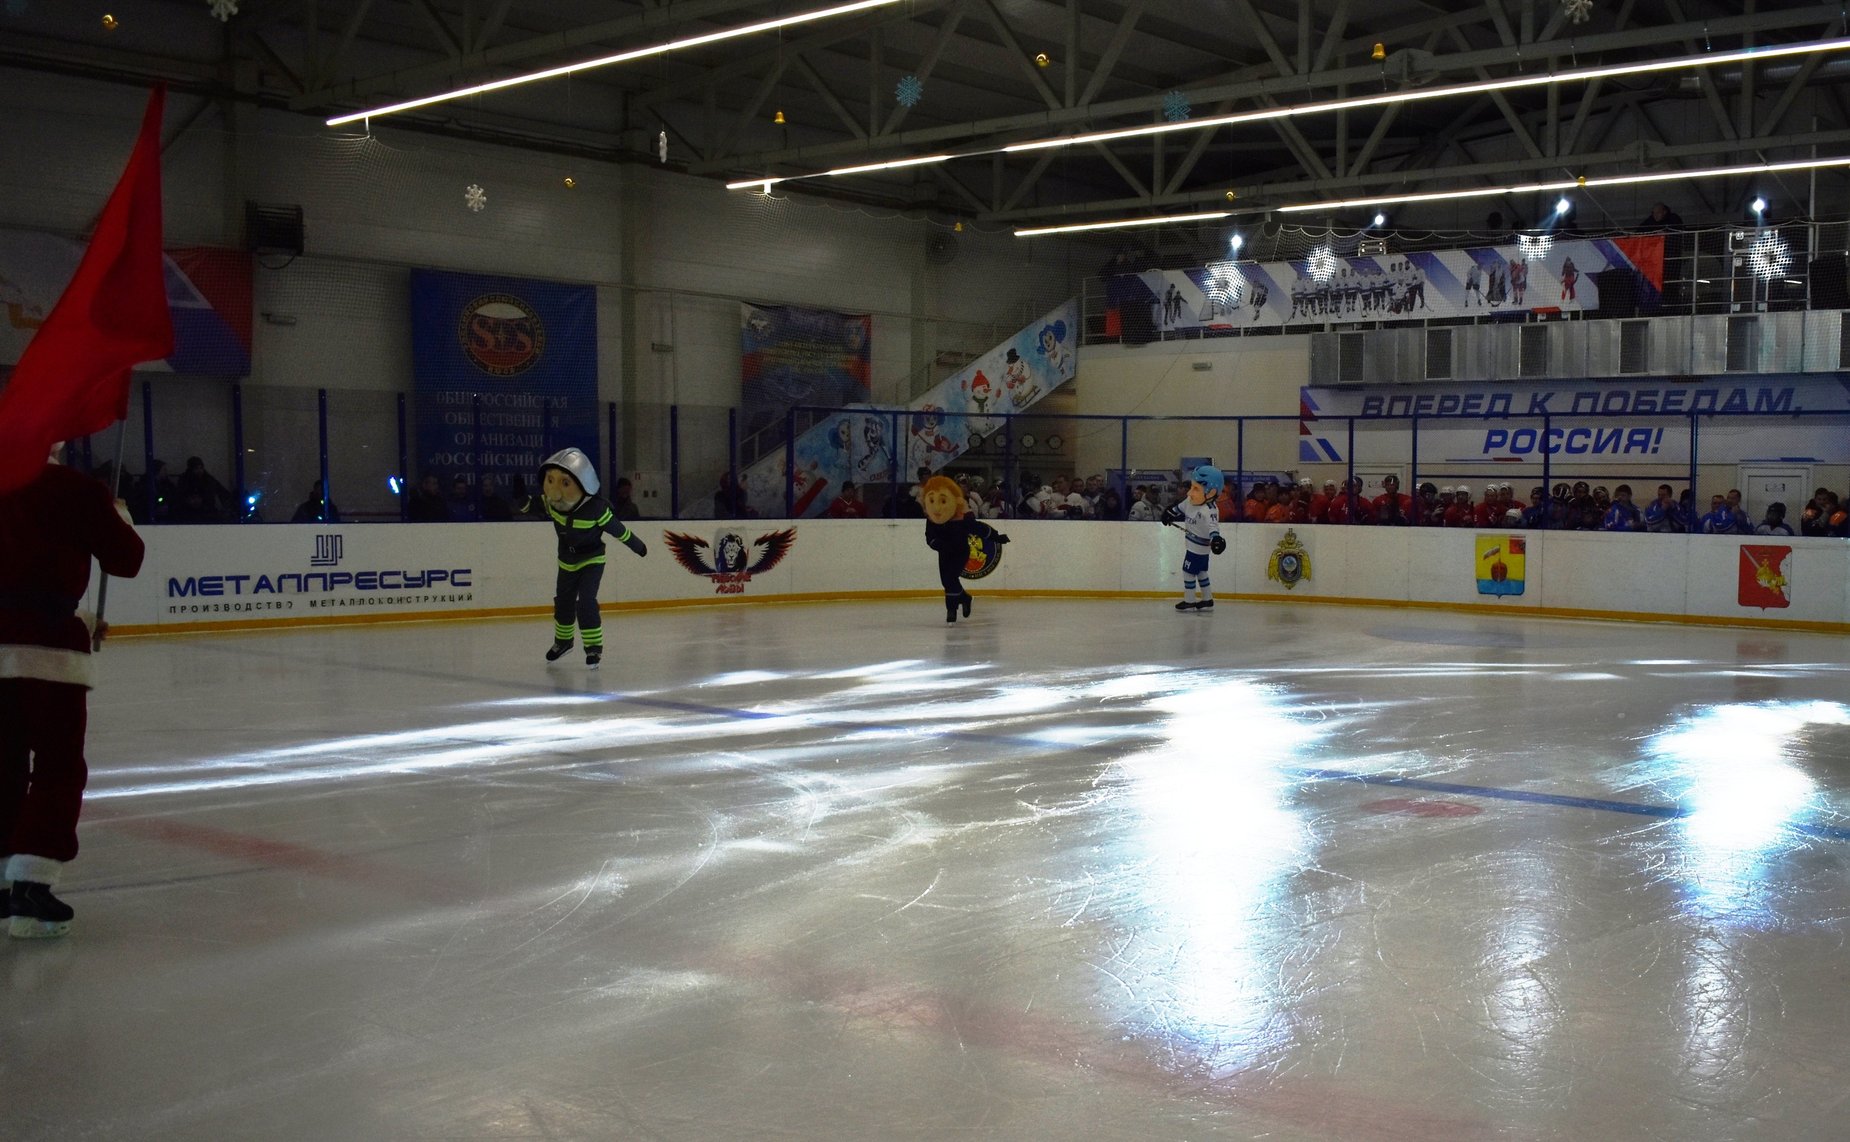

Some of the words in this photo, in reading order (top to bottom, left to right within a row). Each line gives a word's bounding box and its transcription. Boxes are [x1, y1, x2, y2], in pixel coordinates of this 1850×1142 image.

[1361, 393, 1512, 419] ВПЕРЕД
[1527, 392, 1552, 417] К
[1571, 387, 1803, 419] ПОБЕДАМ,
[444, 411, 560, 428] ОБЩЕСТВЕННЯ
[454, 432, 553, 449] ОРАНИЗАЦИ
[1483, 428, 1664, 455] РОССИЯ!
[310, 593, 473, 609] МЕТАЛЛОКОНСТРУКЦИЙ
